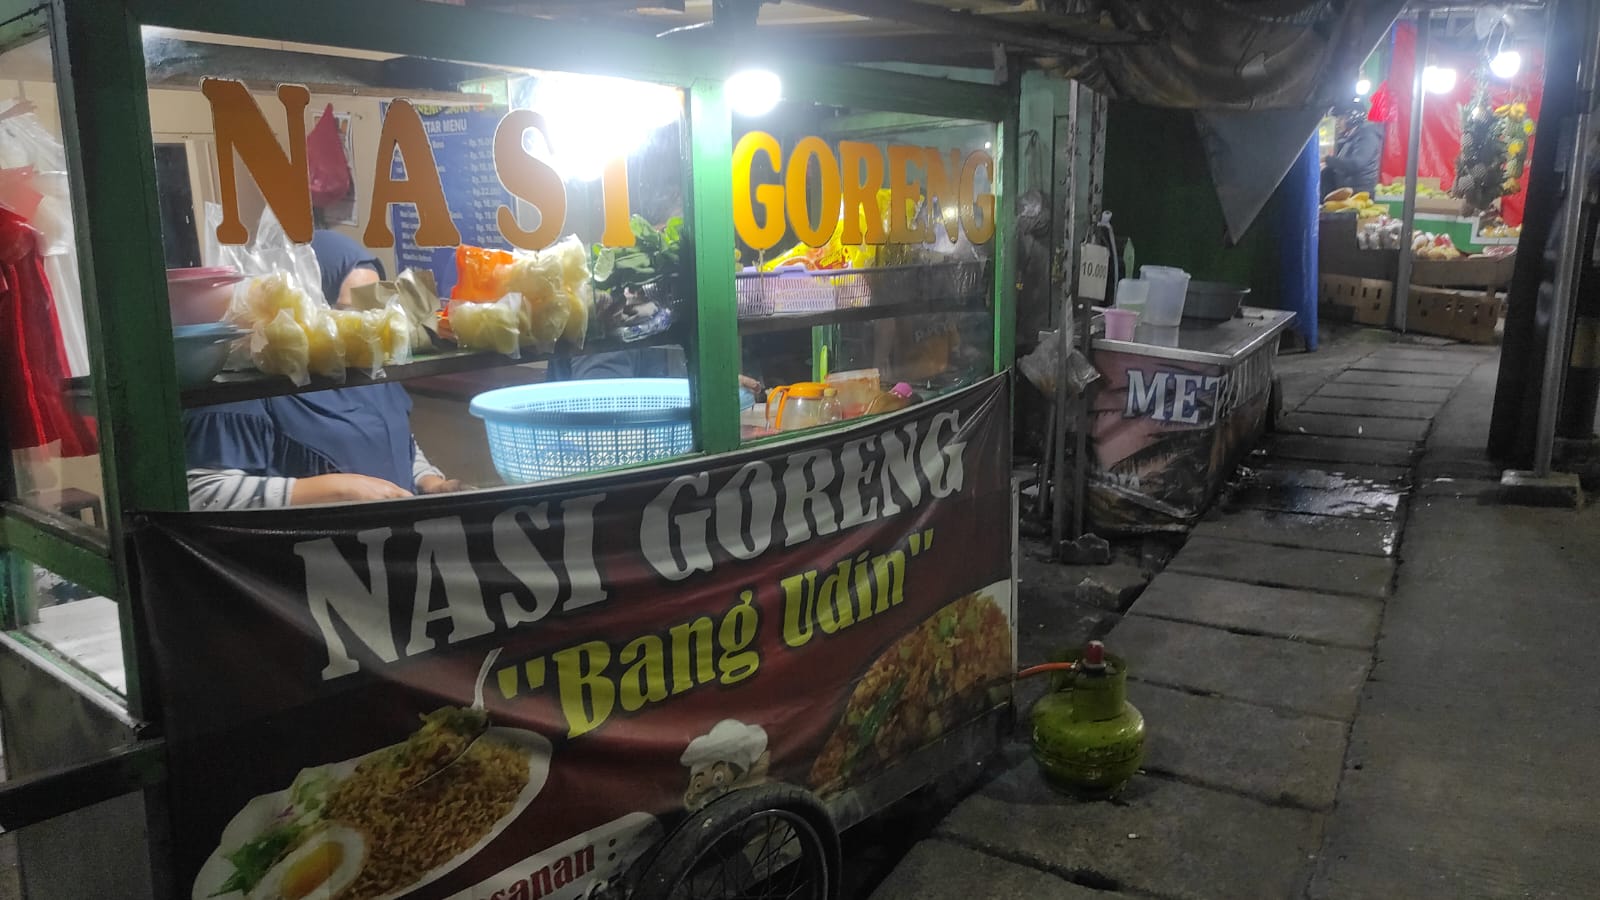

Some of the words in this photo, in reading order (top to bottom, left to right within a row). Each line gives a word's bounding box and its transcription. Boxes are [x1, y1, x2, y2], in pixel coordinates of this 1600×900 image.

[202, 76, 637, 251] NASI
[732, 130, 995, 250] GORENG
[442, 118, 468, 133] MENU
[293, 492, 608, 681] NASI
[639, 407, 967, 582] GORENG
[496, 590, 758, 740] "Bang
[780, 528, 935, 650] Udin"
